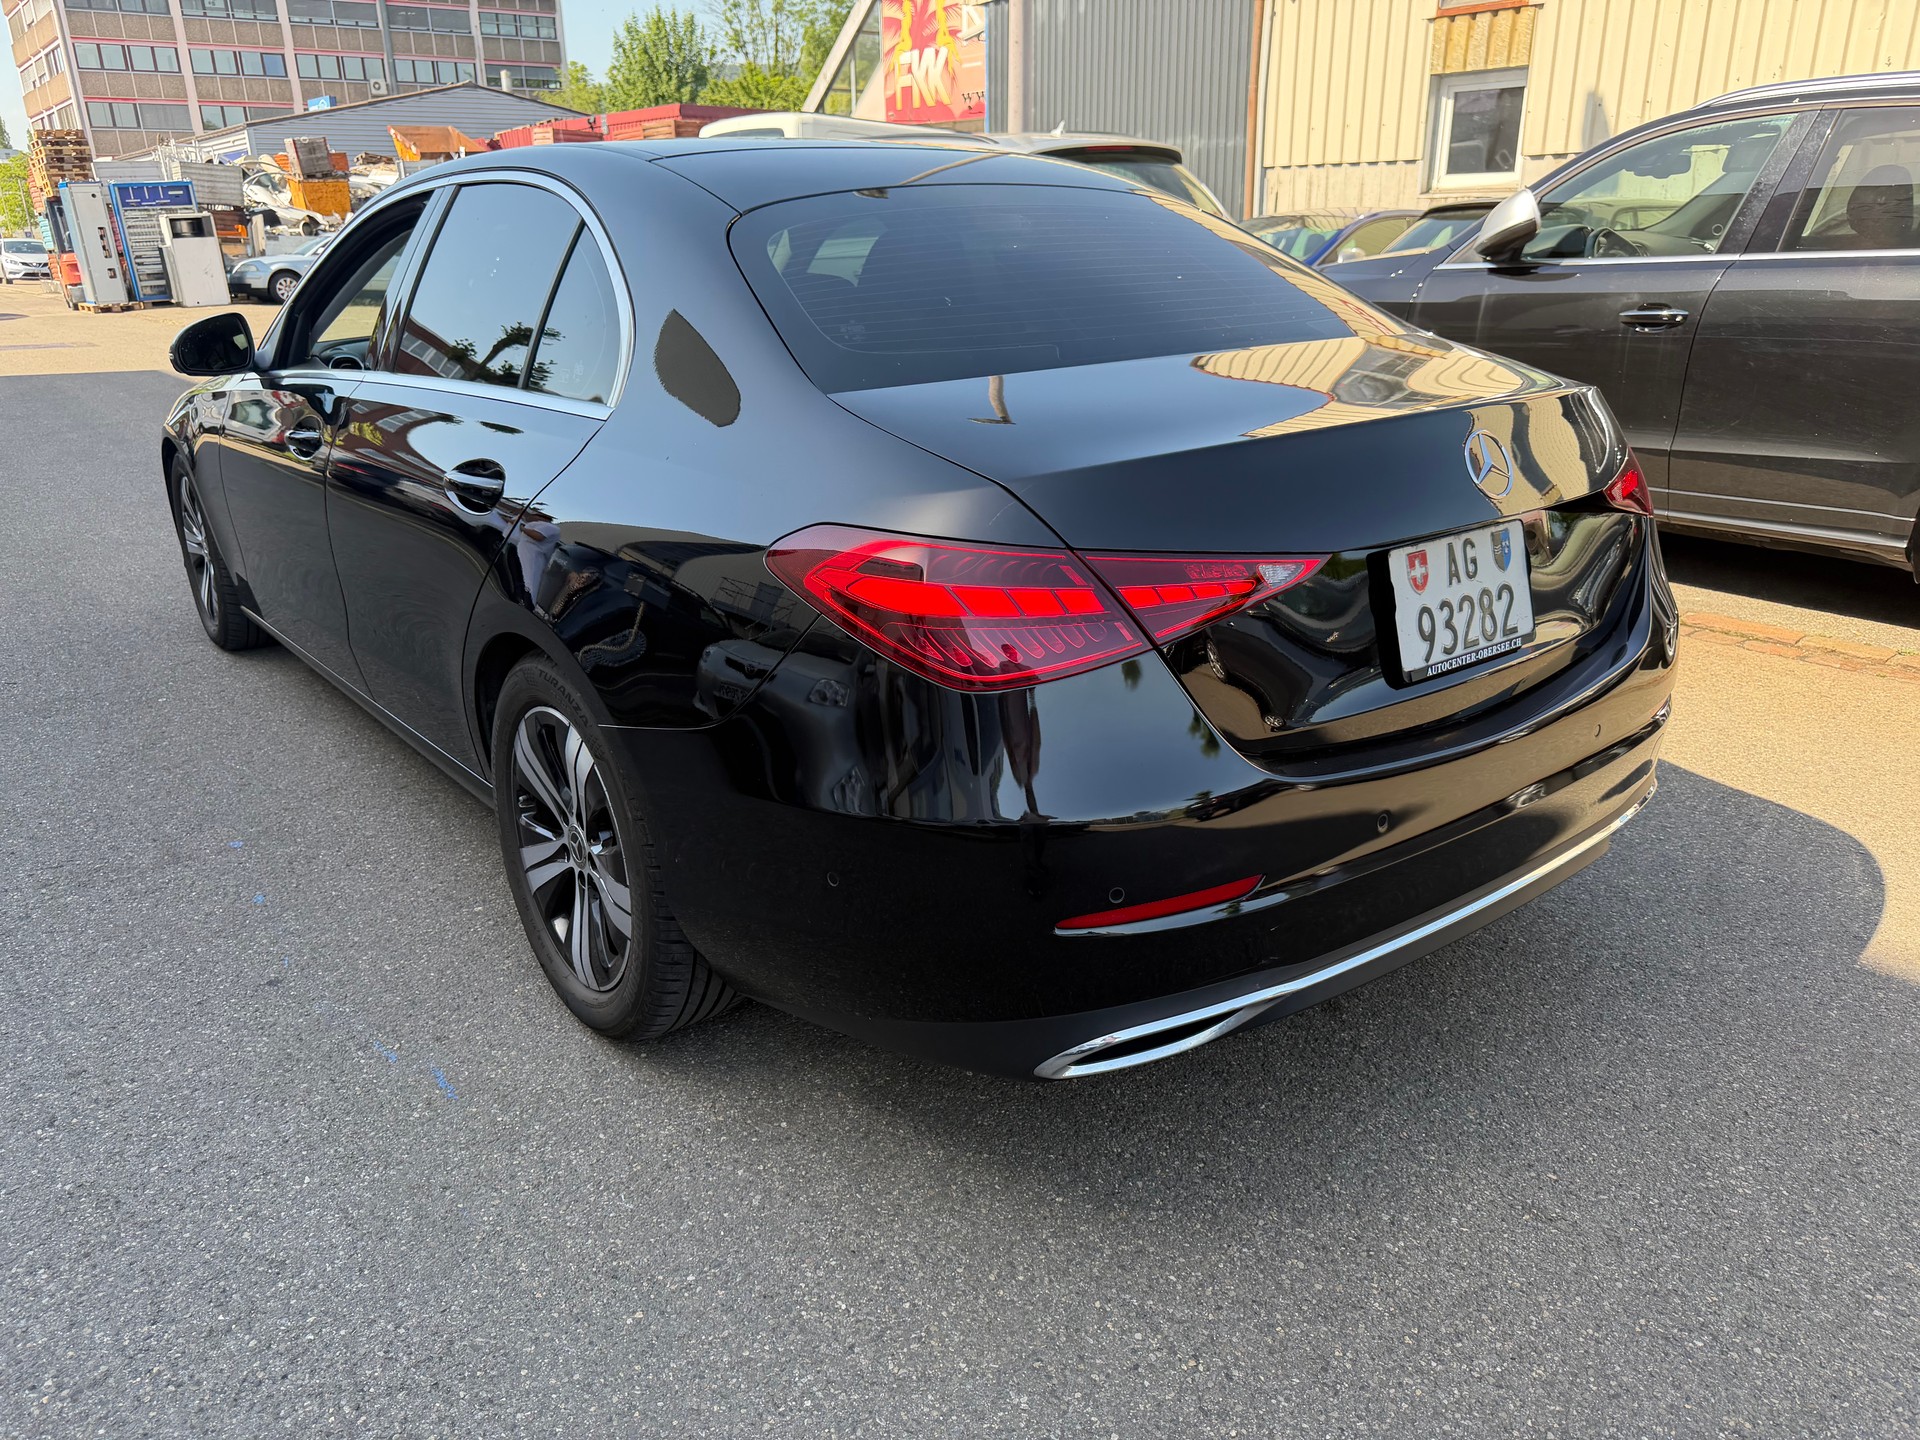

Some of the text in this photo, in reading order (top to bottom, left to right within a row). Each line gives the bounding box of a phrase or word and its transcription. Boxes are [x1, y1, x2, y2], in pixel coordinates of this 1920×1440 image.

[895, 46, 952, 111] FKK
[1447, 537, 1478, 587] AG
[1417, 582, 1519, 664] 93282
[1426, 637, 1523, 677] AUTOCENTER-OBERSEE.CH
[538, 669, 589, 727] TURANZA
